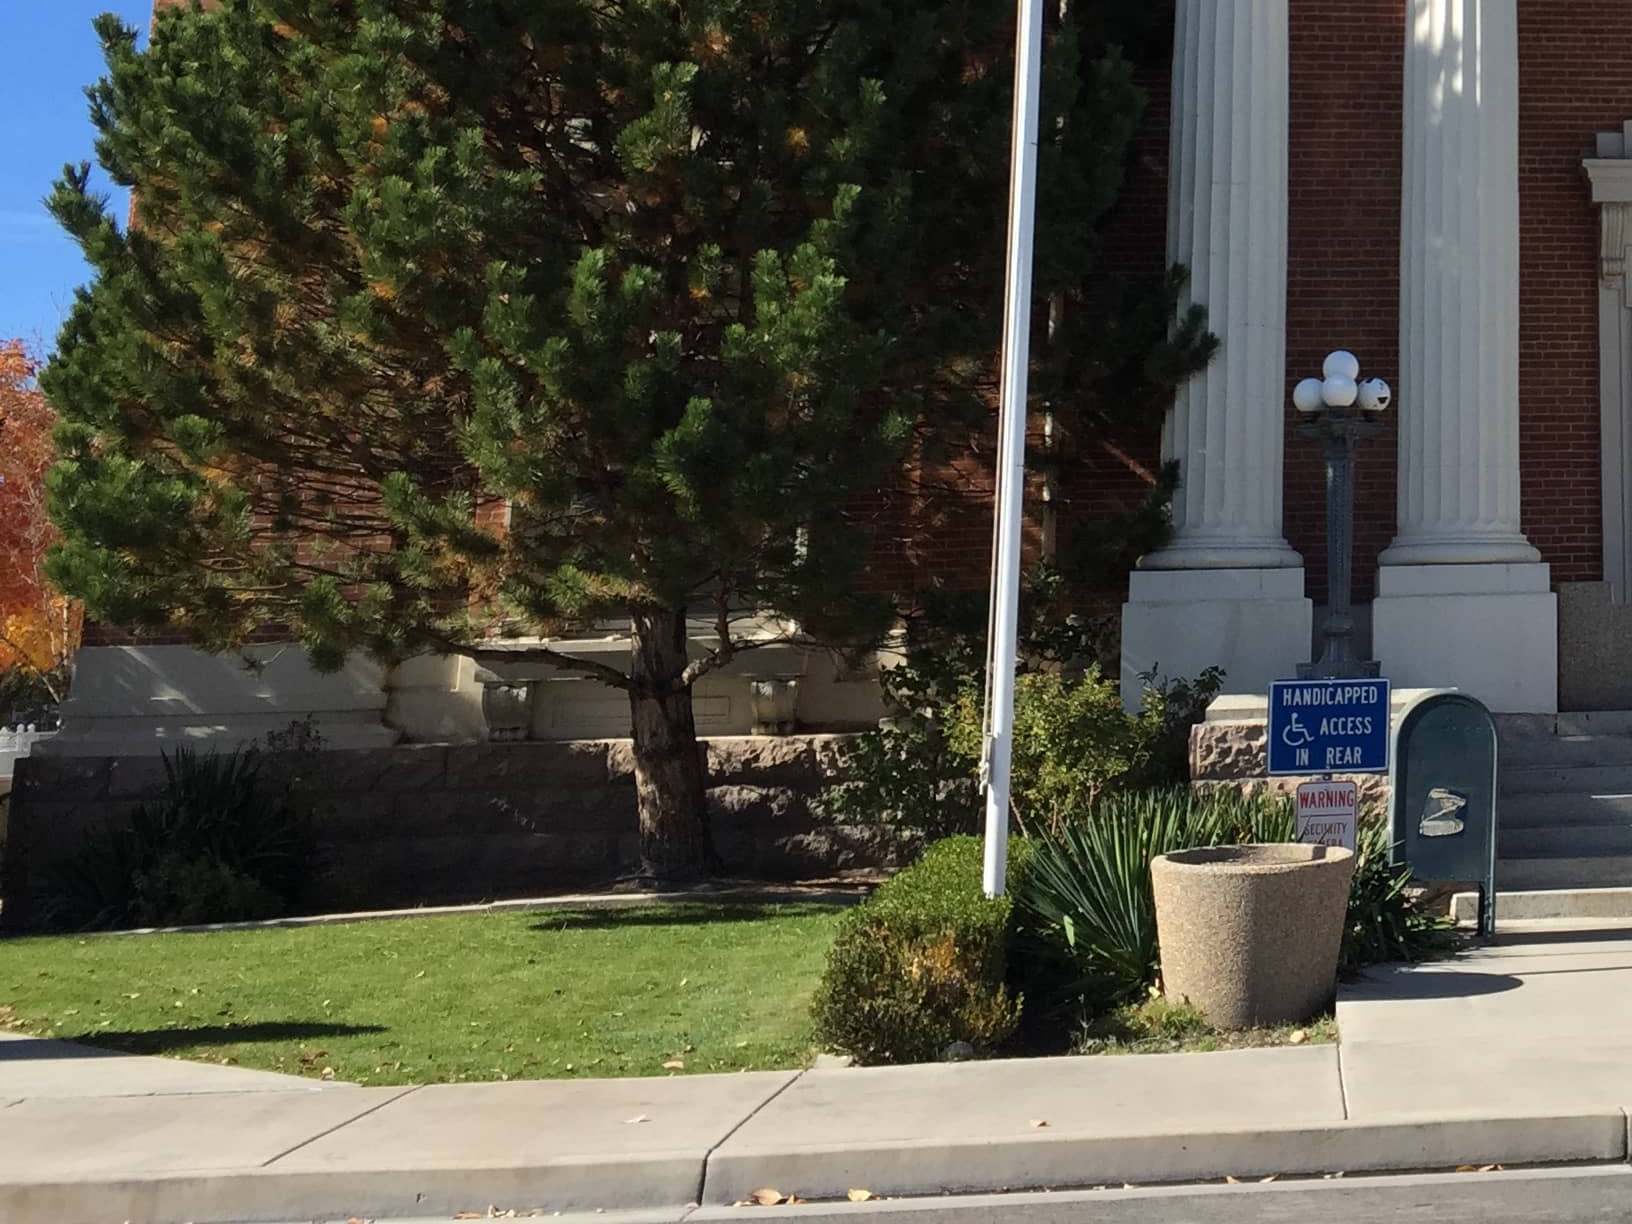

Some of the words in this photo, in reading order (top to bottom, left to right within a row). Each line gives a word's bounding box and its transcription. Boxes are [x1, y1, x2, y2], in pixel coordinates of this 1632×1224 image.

[1283, 686, 1378, 707] HANDICAPPED
[1319, 716, 1373, 736] ACCESS
[1295, 748, 1309, 766] IN
[1326, 746, 1362, 765] REAR
[1300, 790, 1354, 808] WARNING
